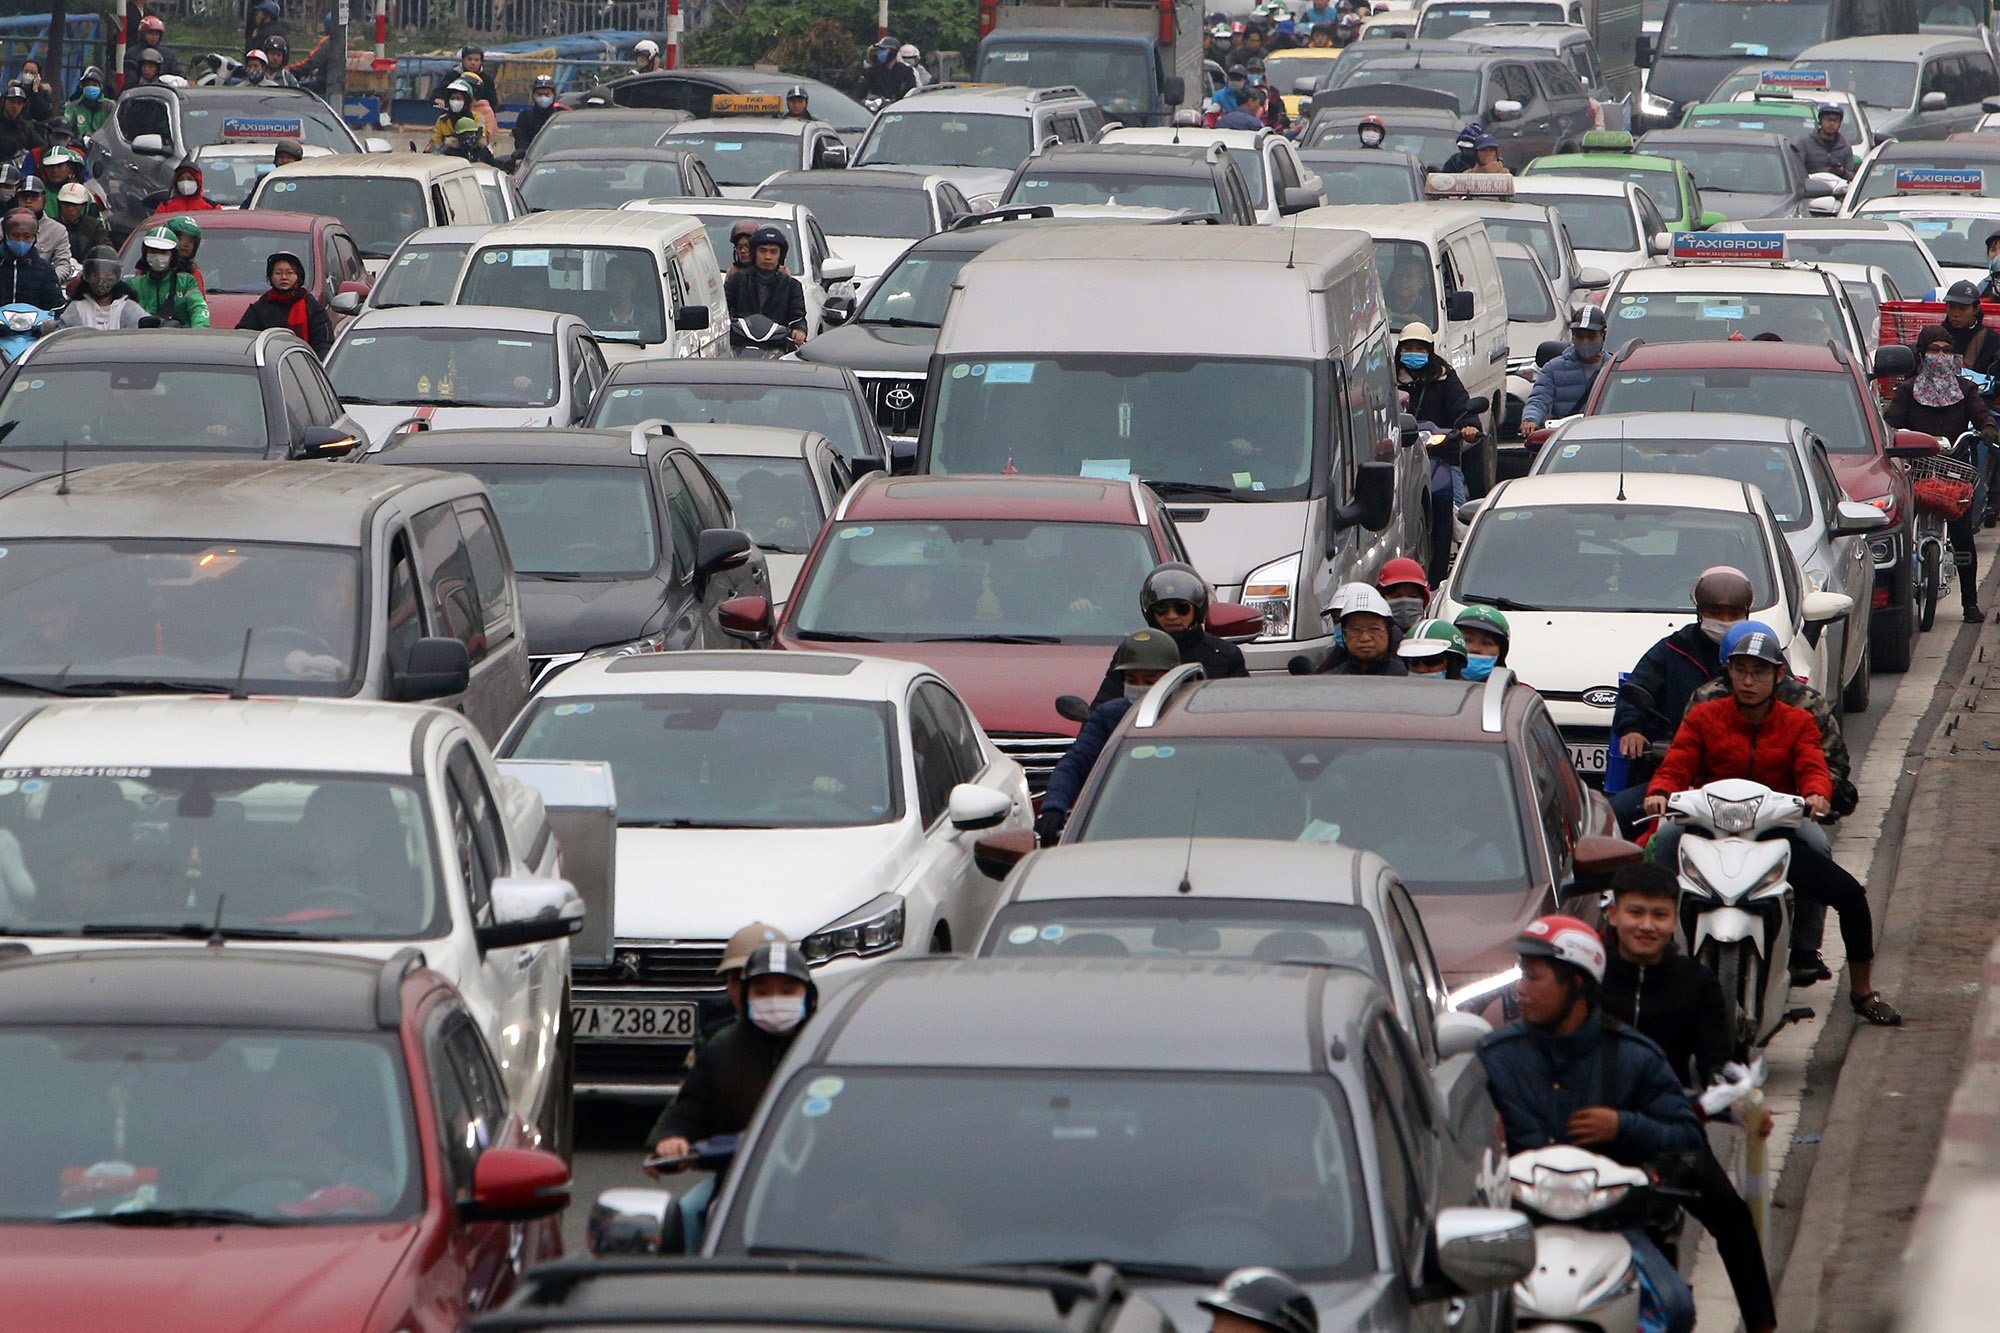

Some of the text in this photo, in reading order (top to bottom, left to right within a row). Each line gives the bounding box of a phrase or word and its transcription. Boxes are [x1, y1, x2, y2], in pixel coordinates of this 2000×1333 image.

[234, 124, 299, 132] TAXIGROUP
[1907, 174, 1980, 183] TAXIGROUP
[1688, 239, 1781, 249] TAXIGROUP
[1592, 692, 1616, 702] Ford
